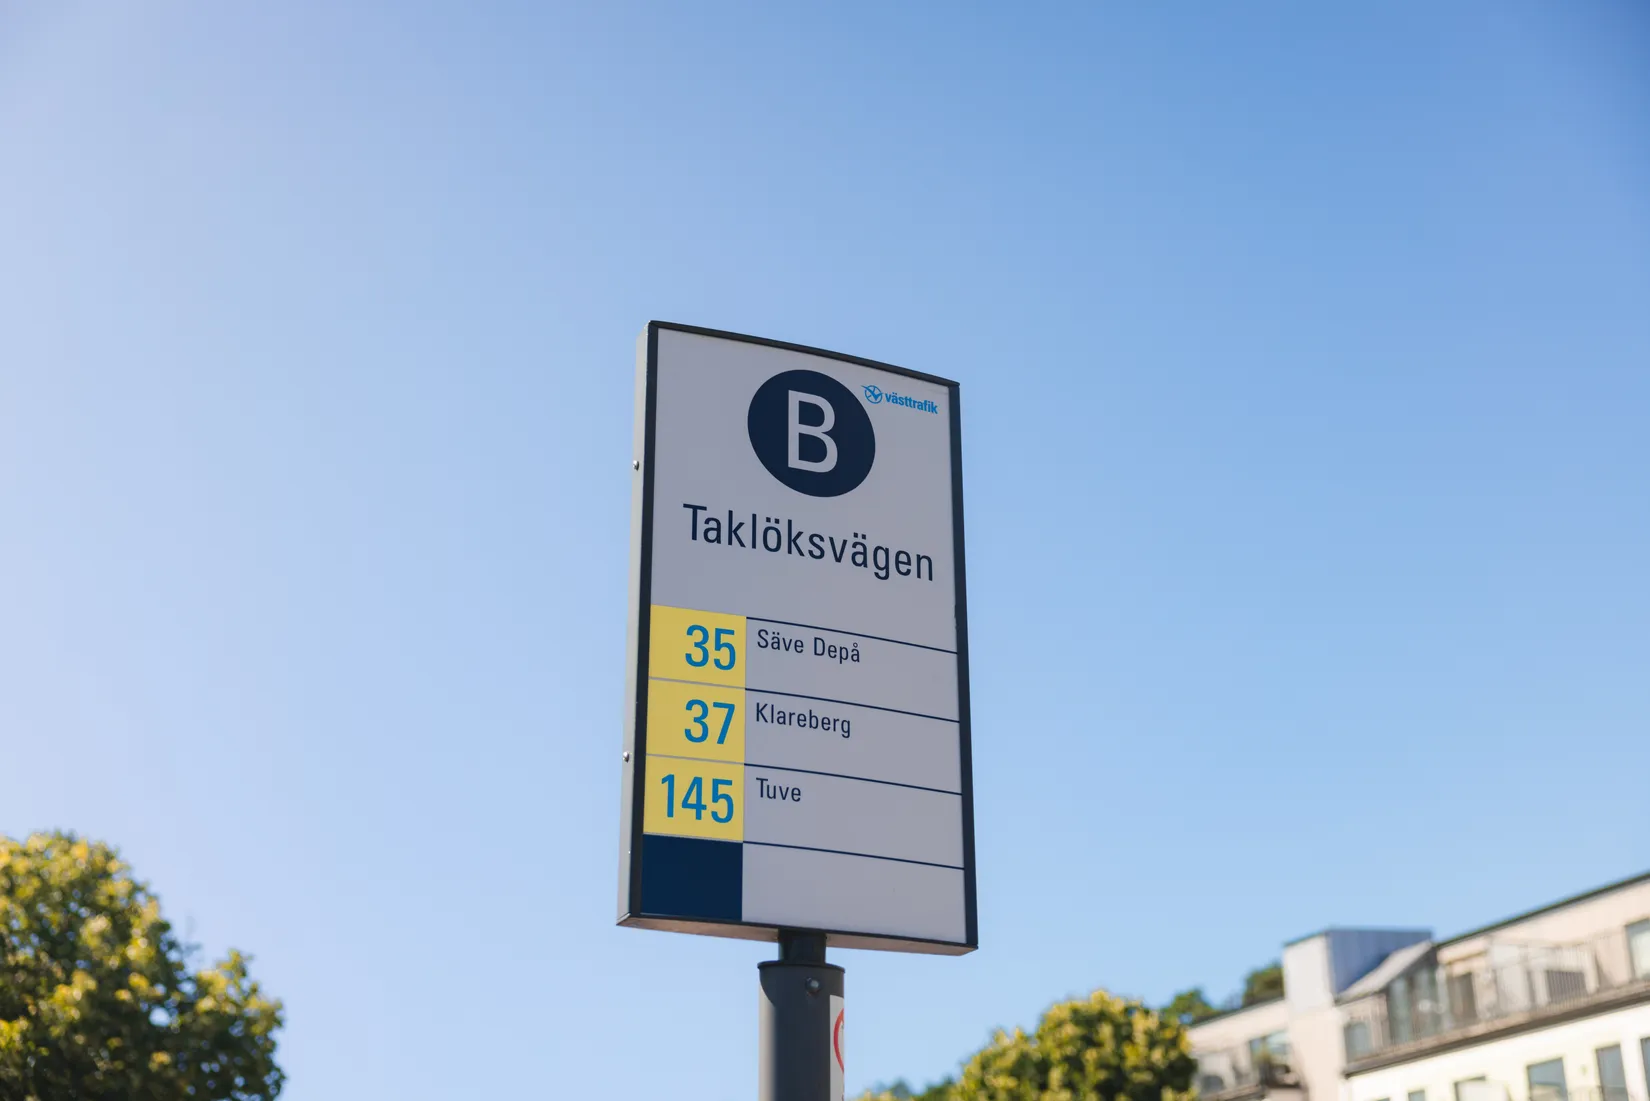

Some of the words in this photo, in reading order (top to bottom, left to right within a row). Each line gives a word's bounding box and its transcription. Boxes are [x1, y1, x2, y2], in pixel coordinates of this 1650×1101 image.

[884, 392, 939, 414] västtrafik
[787, 389, 838, 473] B
[683, 503, 934, 581] Taklöksvägen
[685, 624, 737, 671] 35
[756, 629, 804, 654] Säve
[813, 637, 861, 664] Depå
[684, 699, 736, 745] 37
[755, 702, 851, 738] Klareberg
[660, 773, 735, 824] 145
[755, 777, 802, 802] Tuve
